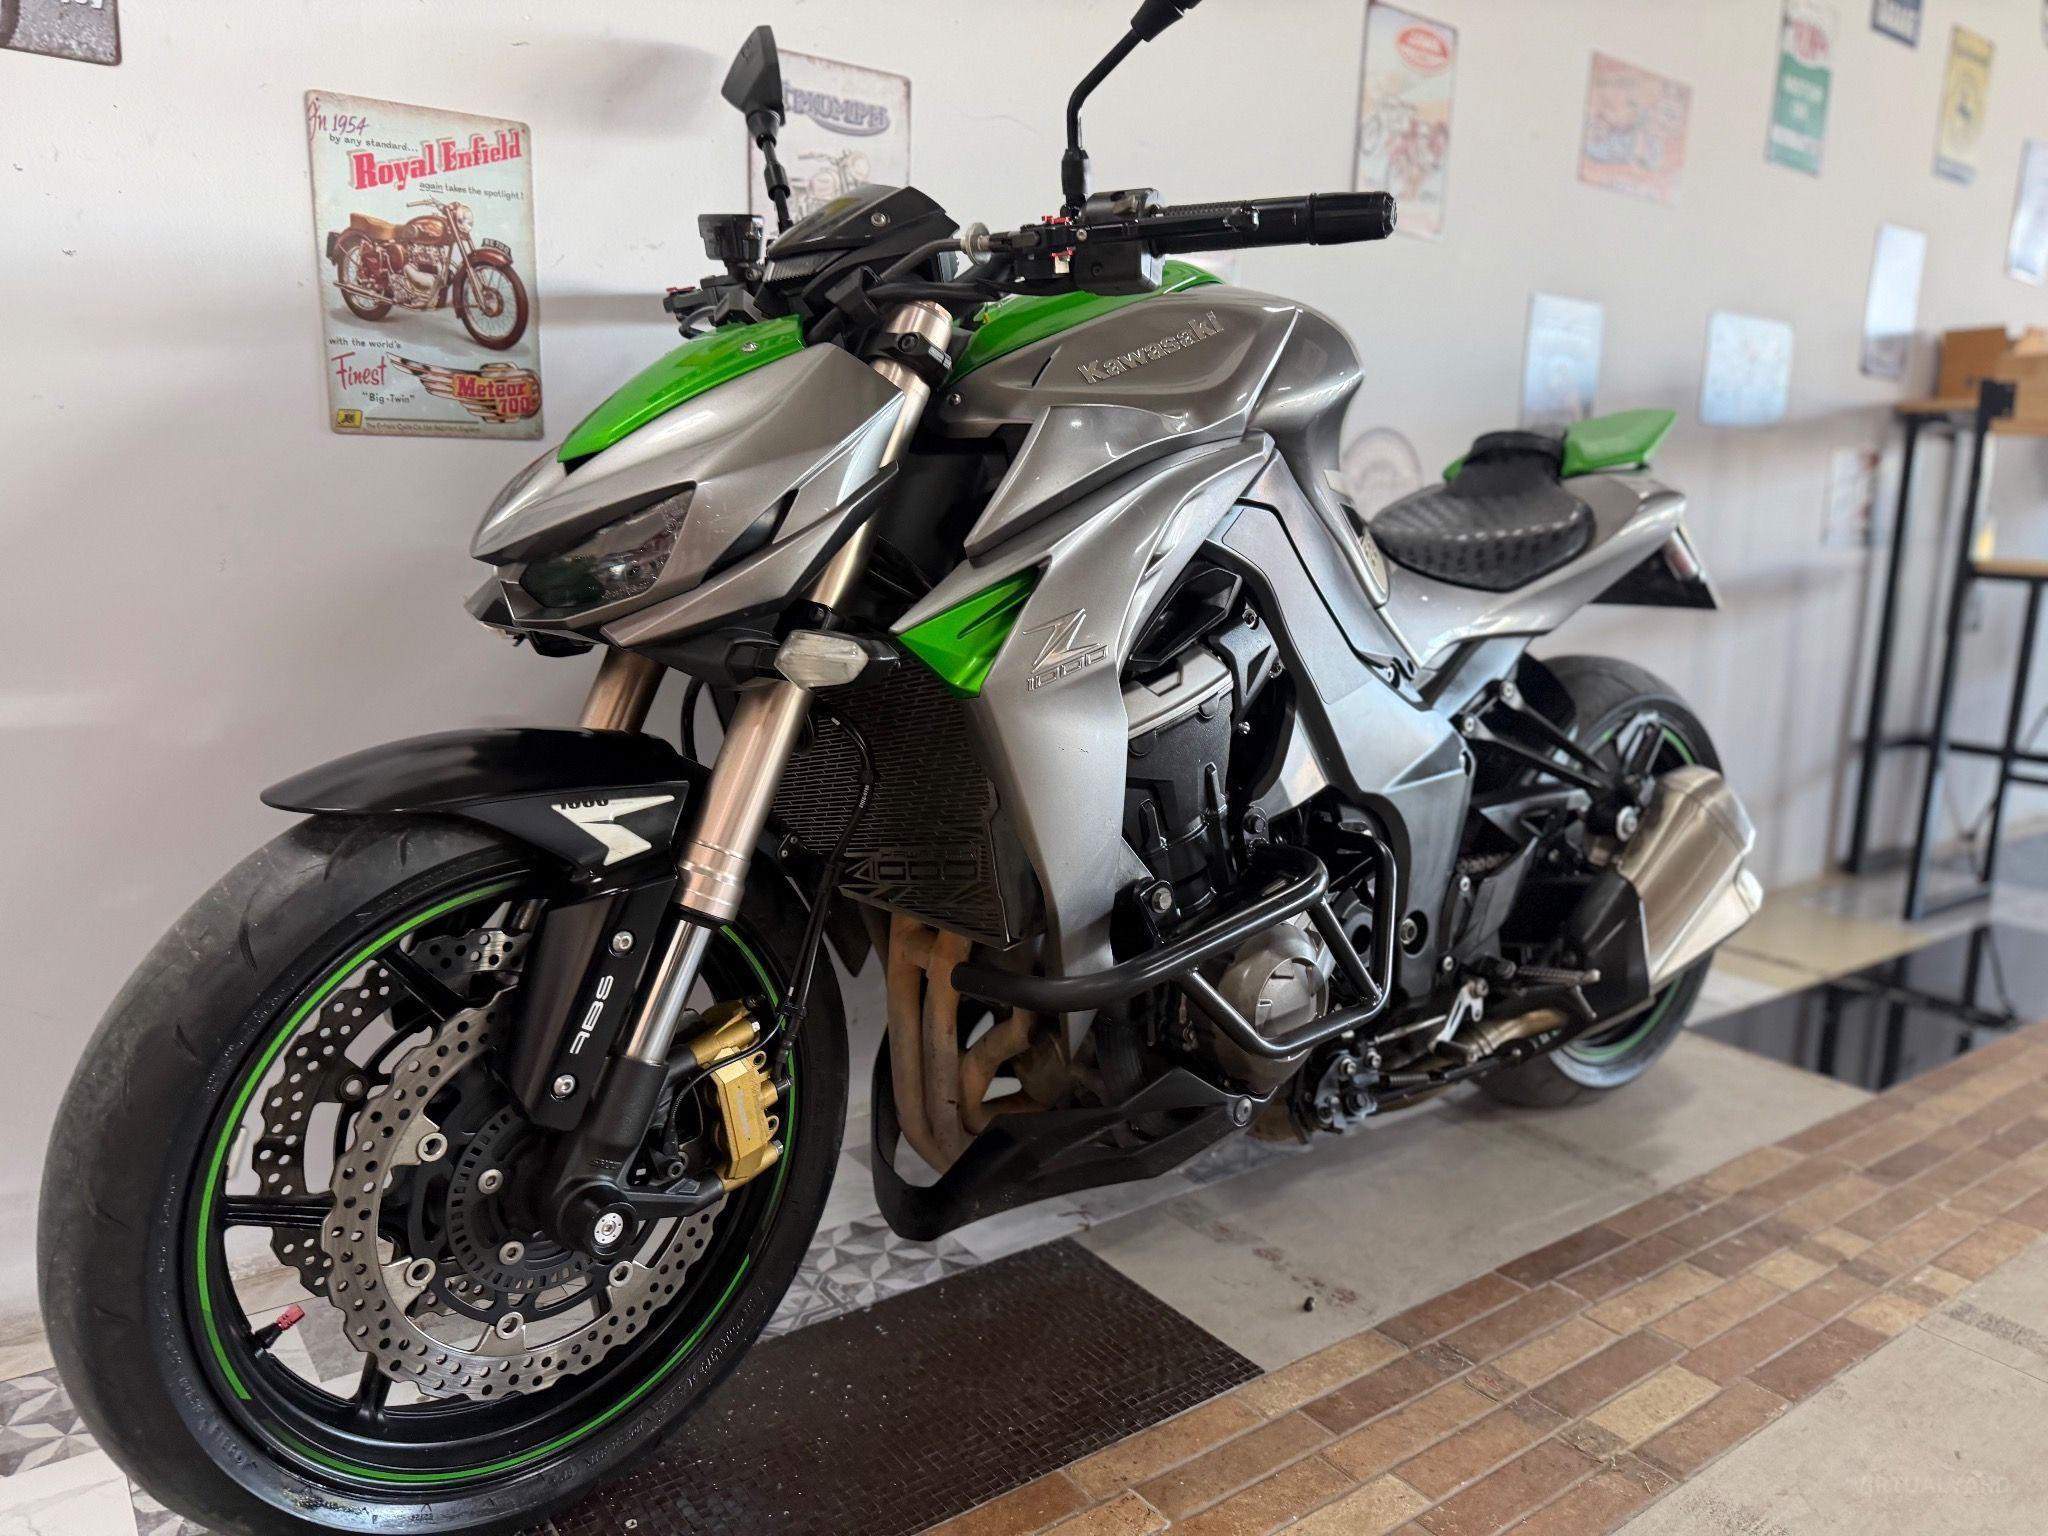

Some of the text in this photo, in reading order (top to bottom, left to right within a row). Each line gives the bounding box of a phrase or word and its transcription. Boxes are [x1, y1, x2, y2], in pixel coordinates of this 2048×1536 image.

[332, 114, 369, 135] 1954
[329, 134, 340, 144] by
[344, 137, 361, 147] any
[352, 129, 522, 191] Royal Enfield
[419, 181, 443, 193] again
[445, 183, 467, 193] takes
[468, 184, 482, 195] the
[329, 336, 348, 345] with
[352, 338, 366, 347] the
[1077, 310, 1224, 384] Kawasaki
[331, 352, 387, 390] Finest
[456, 376, 526, 398] Meteor
[499, 398, 531, 414] 700
[1022, 608, 1101, 673] Z
[1027, 645, 1108, 691] 1000
